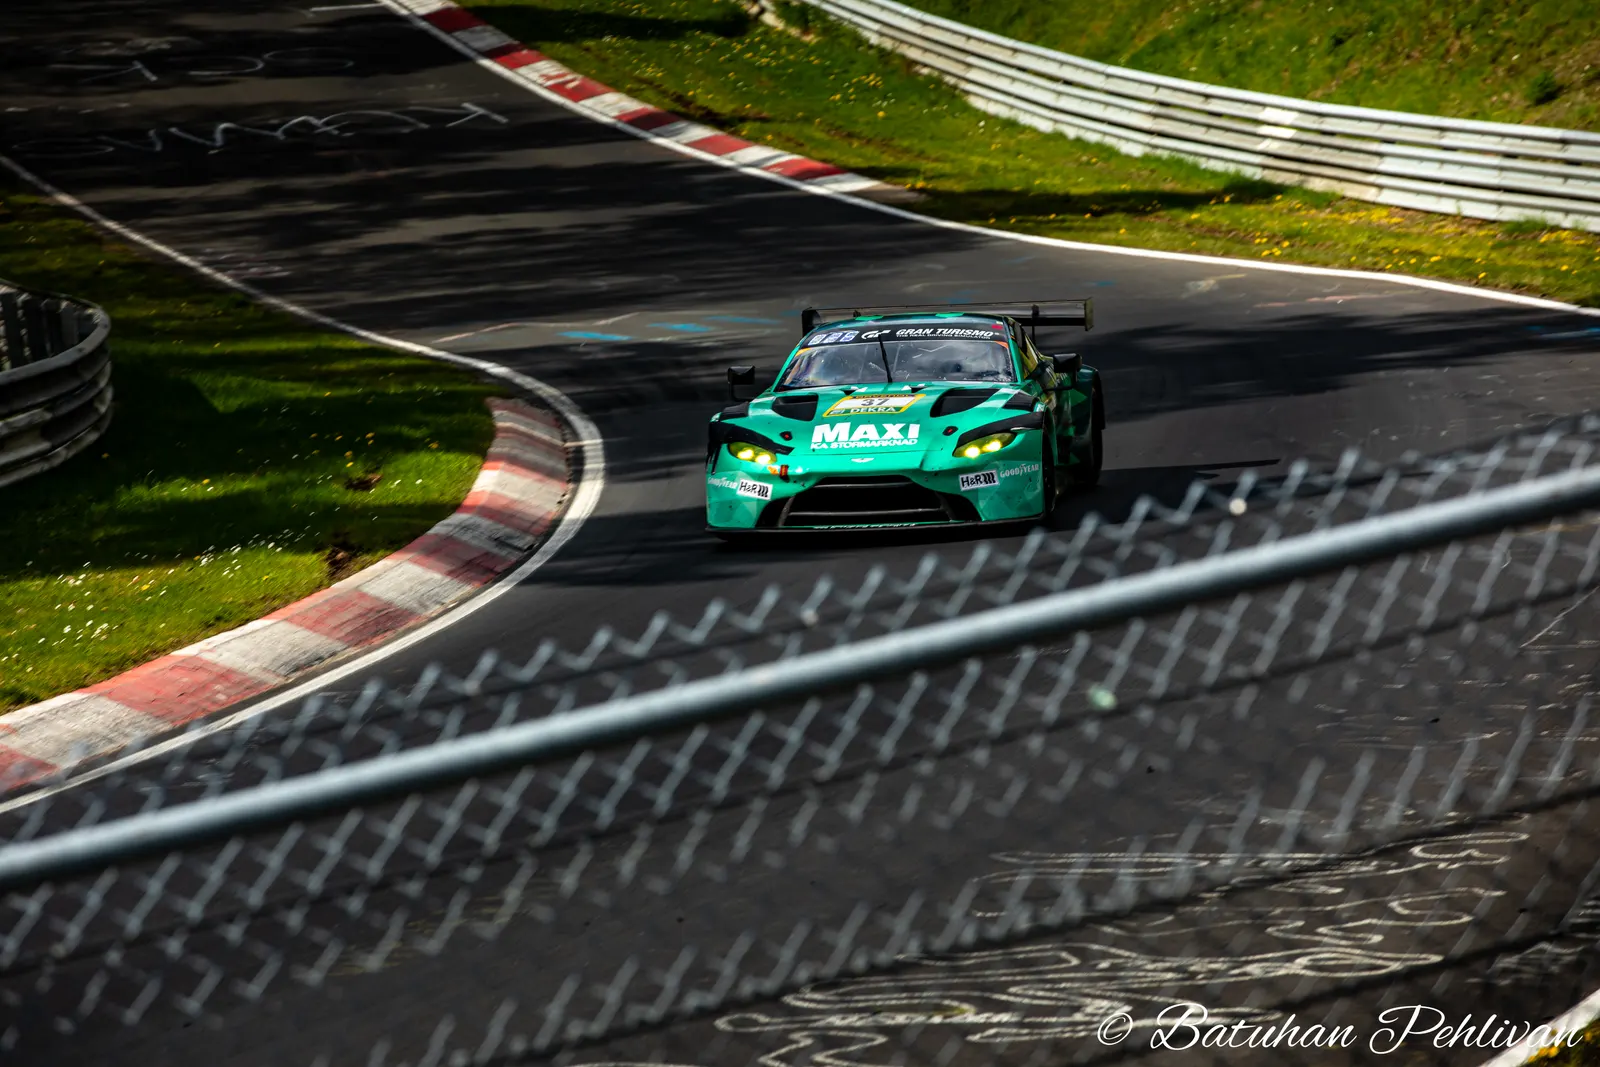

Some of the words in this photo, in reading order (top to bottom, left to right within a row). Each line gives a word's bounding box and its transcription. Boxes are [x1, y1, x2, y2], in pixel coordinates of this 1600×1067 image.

[936, 328, 993, 337] TURISMO
[861, 398, 890, 406] 37
[811, 422, 920, 443] MAXI
[829, 438, 919, 449] STORMARKNAD
[1000, 463, 1039, 478] GOODYEAR
